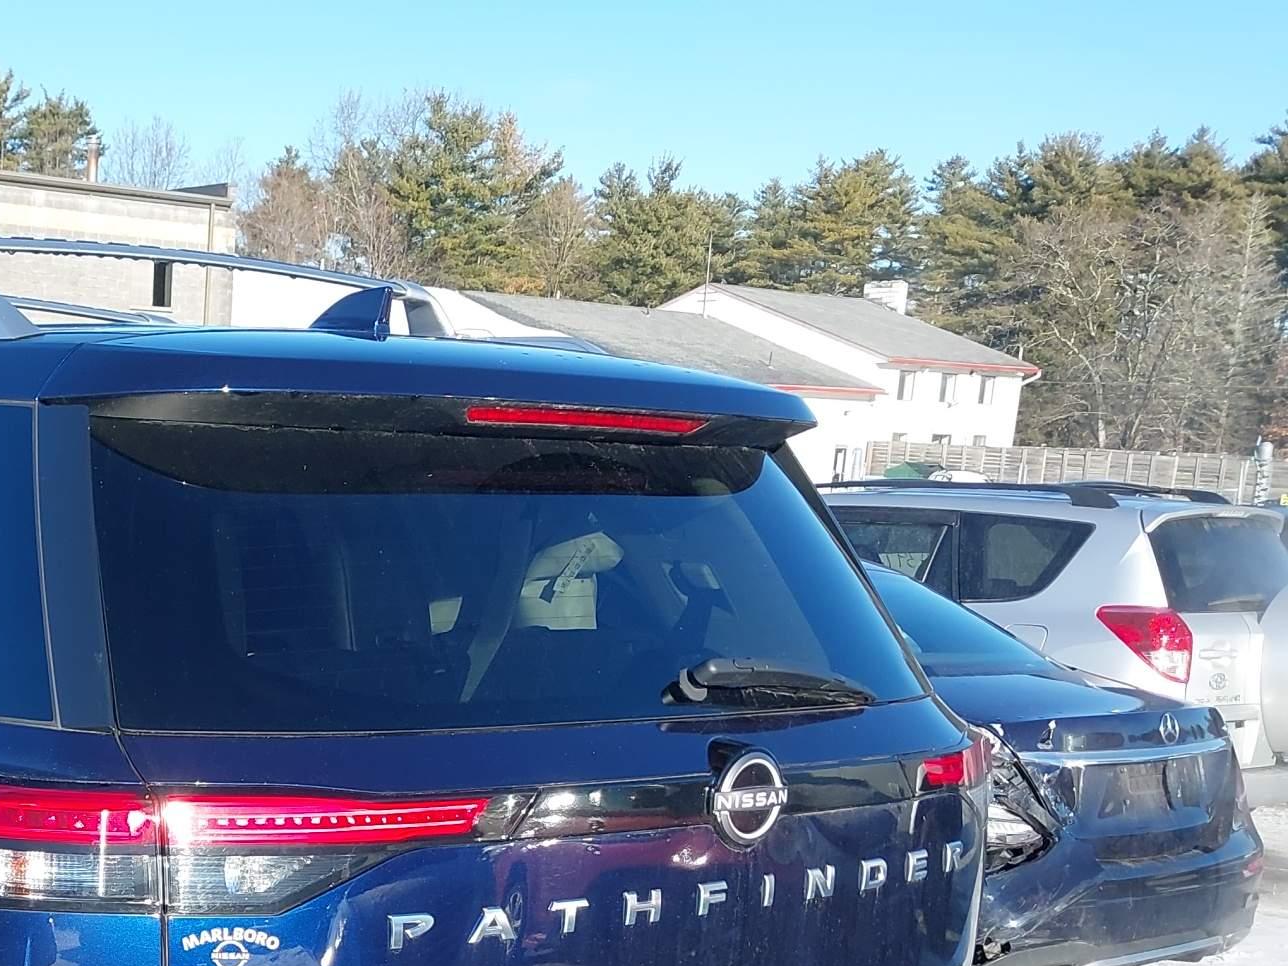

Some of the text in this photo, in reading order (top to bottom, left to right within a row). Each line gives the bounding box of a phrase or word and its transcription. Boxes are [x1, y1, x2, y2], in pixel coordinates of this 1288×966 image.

[717, 788, 788, 810] NISSAN
[389, 841, 963, 950] PATHFINDER
[181, 927, 280, 951] MARLBORO
[210, 951, 250, 961] NISSAN
